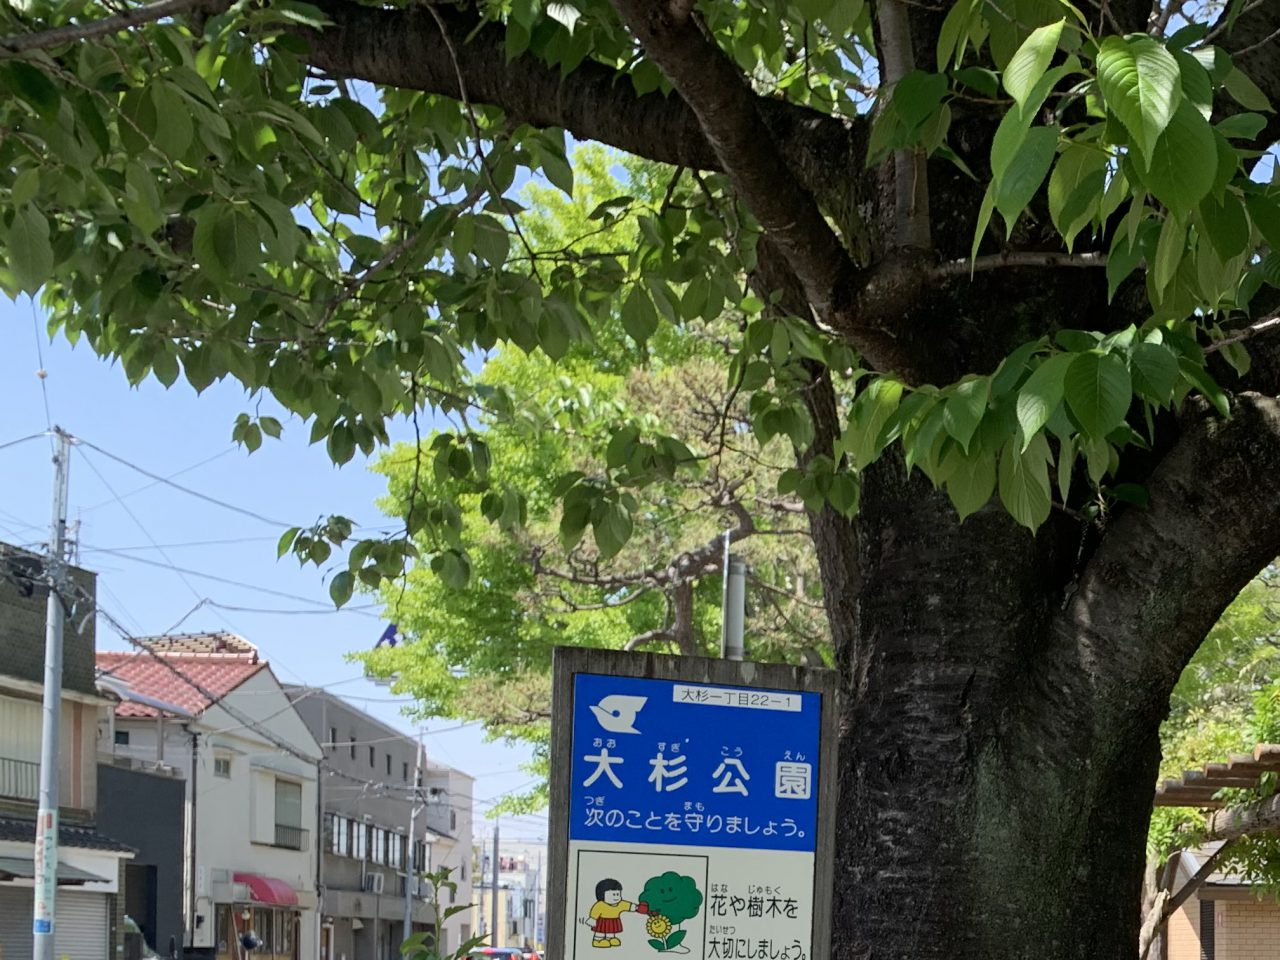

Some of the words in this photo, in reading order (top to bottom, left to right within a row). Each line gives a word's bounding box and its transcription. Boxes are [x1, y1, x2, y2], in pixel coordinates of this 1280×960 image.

[592, 738, 616, 749] おお
[657, 743, 681, 753] すぎ
[720, 746, 743, 757] こう
[784, 751, 806, 761] えん
[583, 748, 812, 800] 大杉公園
[584, 796, 605, 806] つぎ
[683, 801, 705, 811] まも
[584, 808, 805, 838] 次のことを守りましょう。
[711, 883, 728, 893] はな
[710, 894, 798, 919] 花や樹木を
[708, 937, 806, 960] 大切にしましょう。
